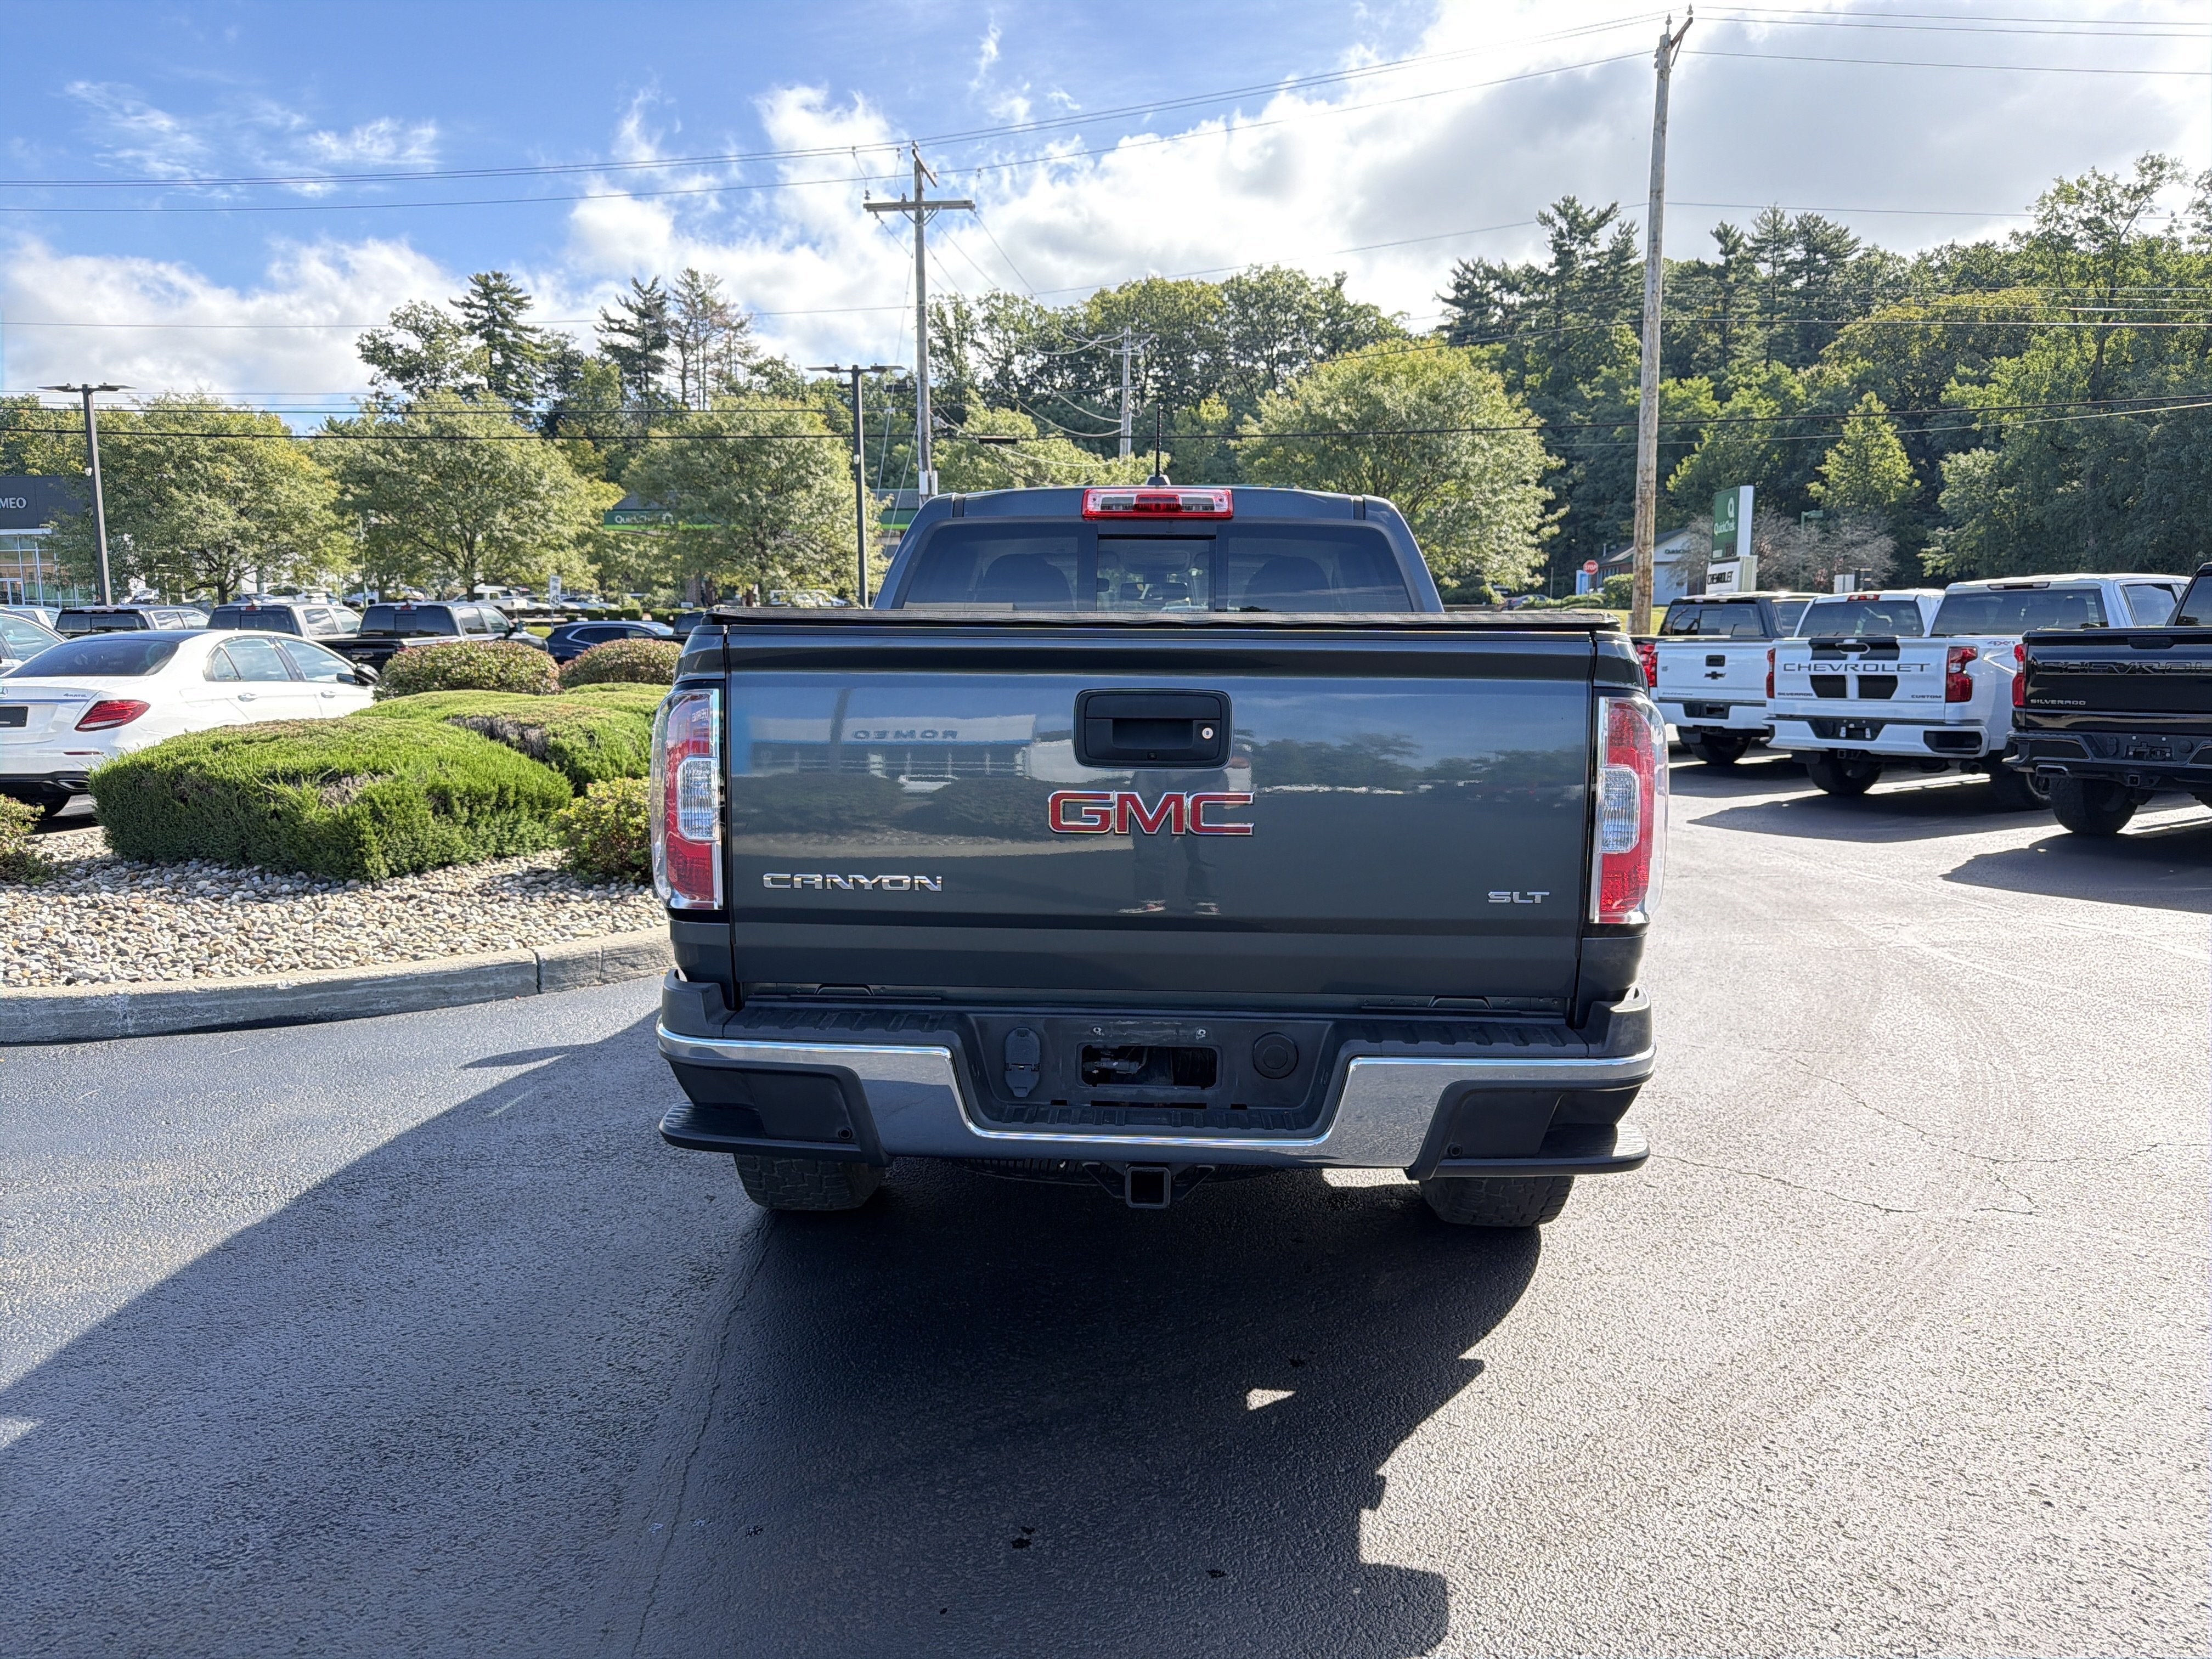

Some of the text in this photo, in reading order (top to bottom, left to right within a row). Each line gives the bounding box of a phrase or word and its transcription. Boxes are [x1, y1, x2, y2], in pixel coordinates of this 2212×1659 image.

[0, 497, 27, 509] MEO
[551, 595, 560, 606] 45
[1783, 663, 1931, 672] CHEVROLET
[1048, 790, 1255, 836] GMC
[763, 873, 943, 891] CANYON
[1488, 891, 1550, 904] SLT
